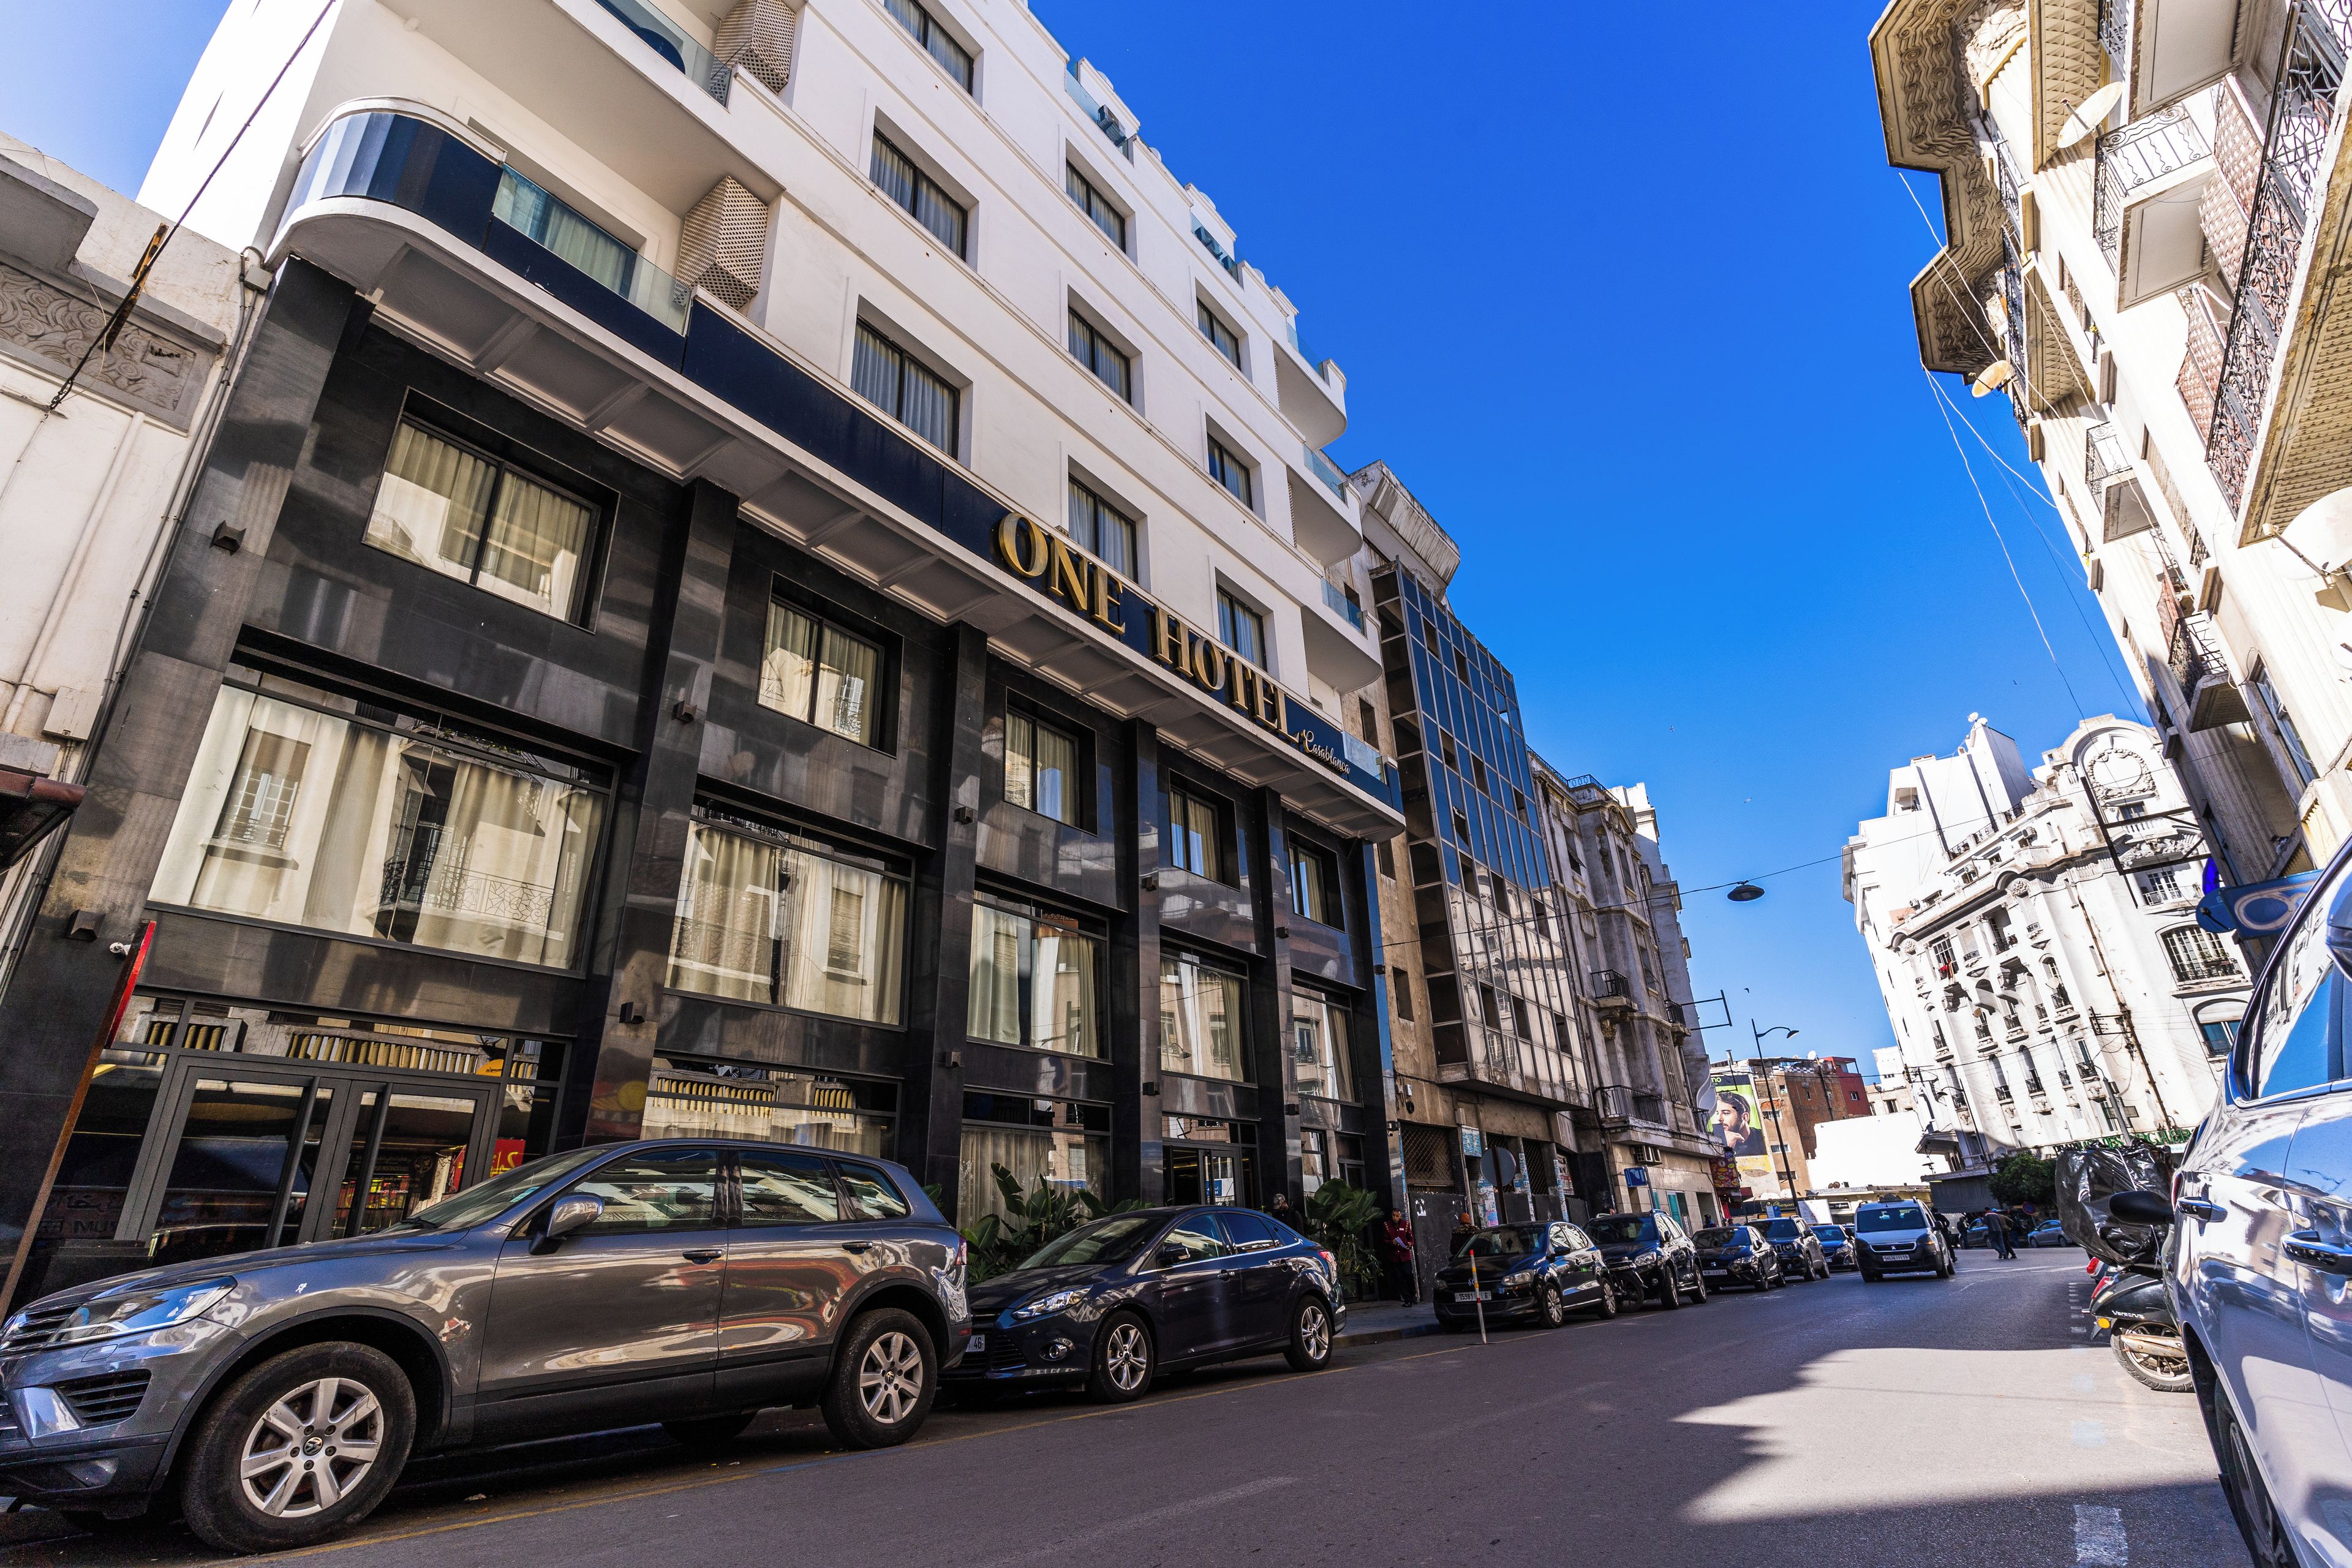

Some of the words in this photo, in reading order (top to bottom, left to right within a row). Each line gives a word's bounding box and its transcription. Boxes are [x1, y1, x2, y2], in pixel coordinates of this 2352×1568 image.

[999, 512, 1125, 635] ONE
[1155, 605, 1299, 742] HOTEL
[1301, 729, 1350, 774] Casablanca
[974, 1336, 982, 1349] 46
